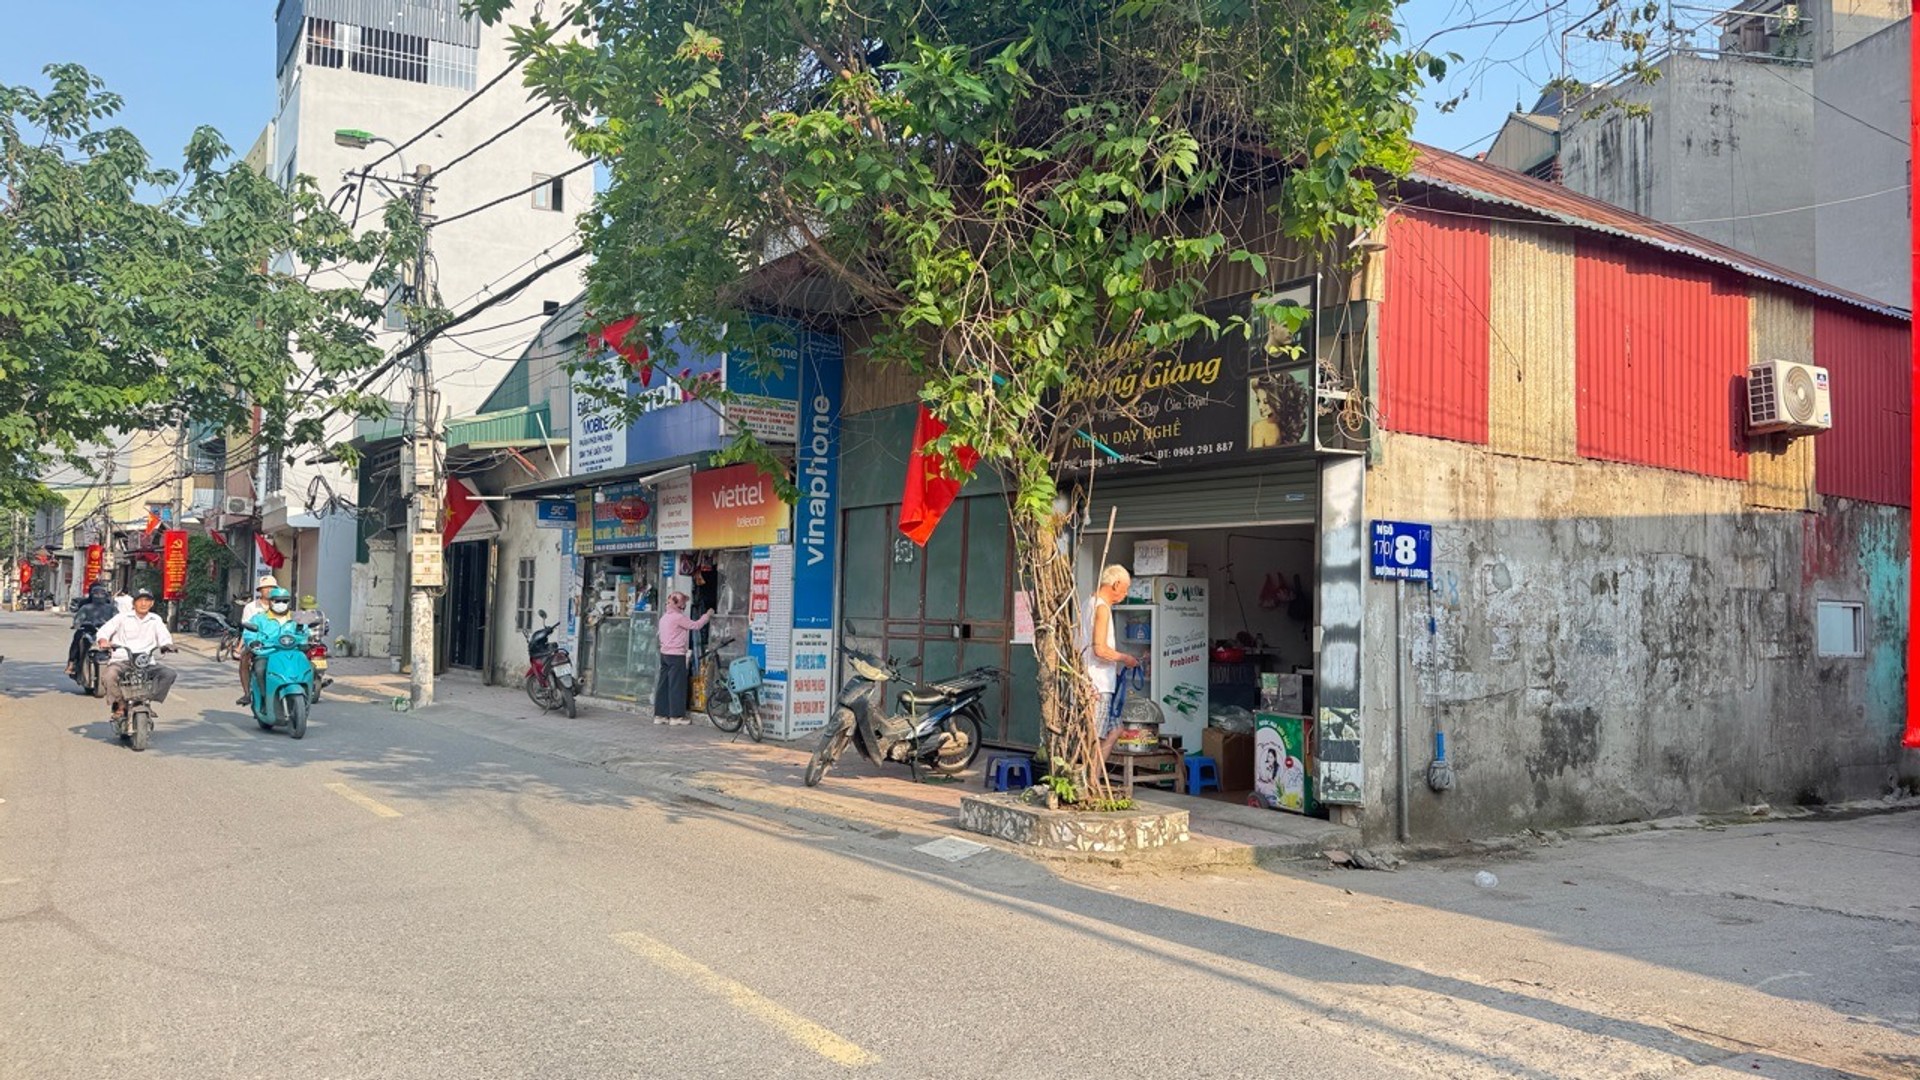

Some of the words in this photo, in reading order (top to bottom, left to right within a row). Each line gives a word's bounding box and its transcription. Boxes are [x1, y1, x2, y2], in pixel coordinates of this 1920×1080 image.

[1143, 357, 1222, 388] Giang
[1113, 428, 1139, 447] DẠY
[1143, 418, 1181, 440] NGHỀ
[1173, 446, 1194, 458] 0968
[1197, 444, 1213, 455] 291
[1216, 441, 1234, 452] 887
[803, 394, 831, 566] vinaphone
[712, 481, 764, 509] viettel
[736, 515, 765, 528] telecom
[1375, 565, 1396, 576] ĐƯỜNG
[1410, 568, 1428, 579] LƯƠNG
[1169, 653, 1200, 668] Probiotic
